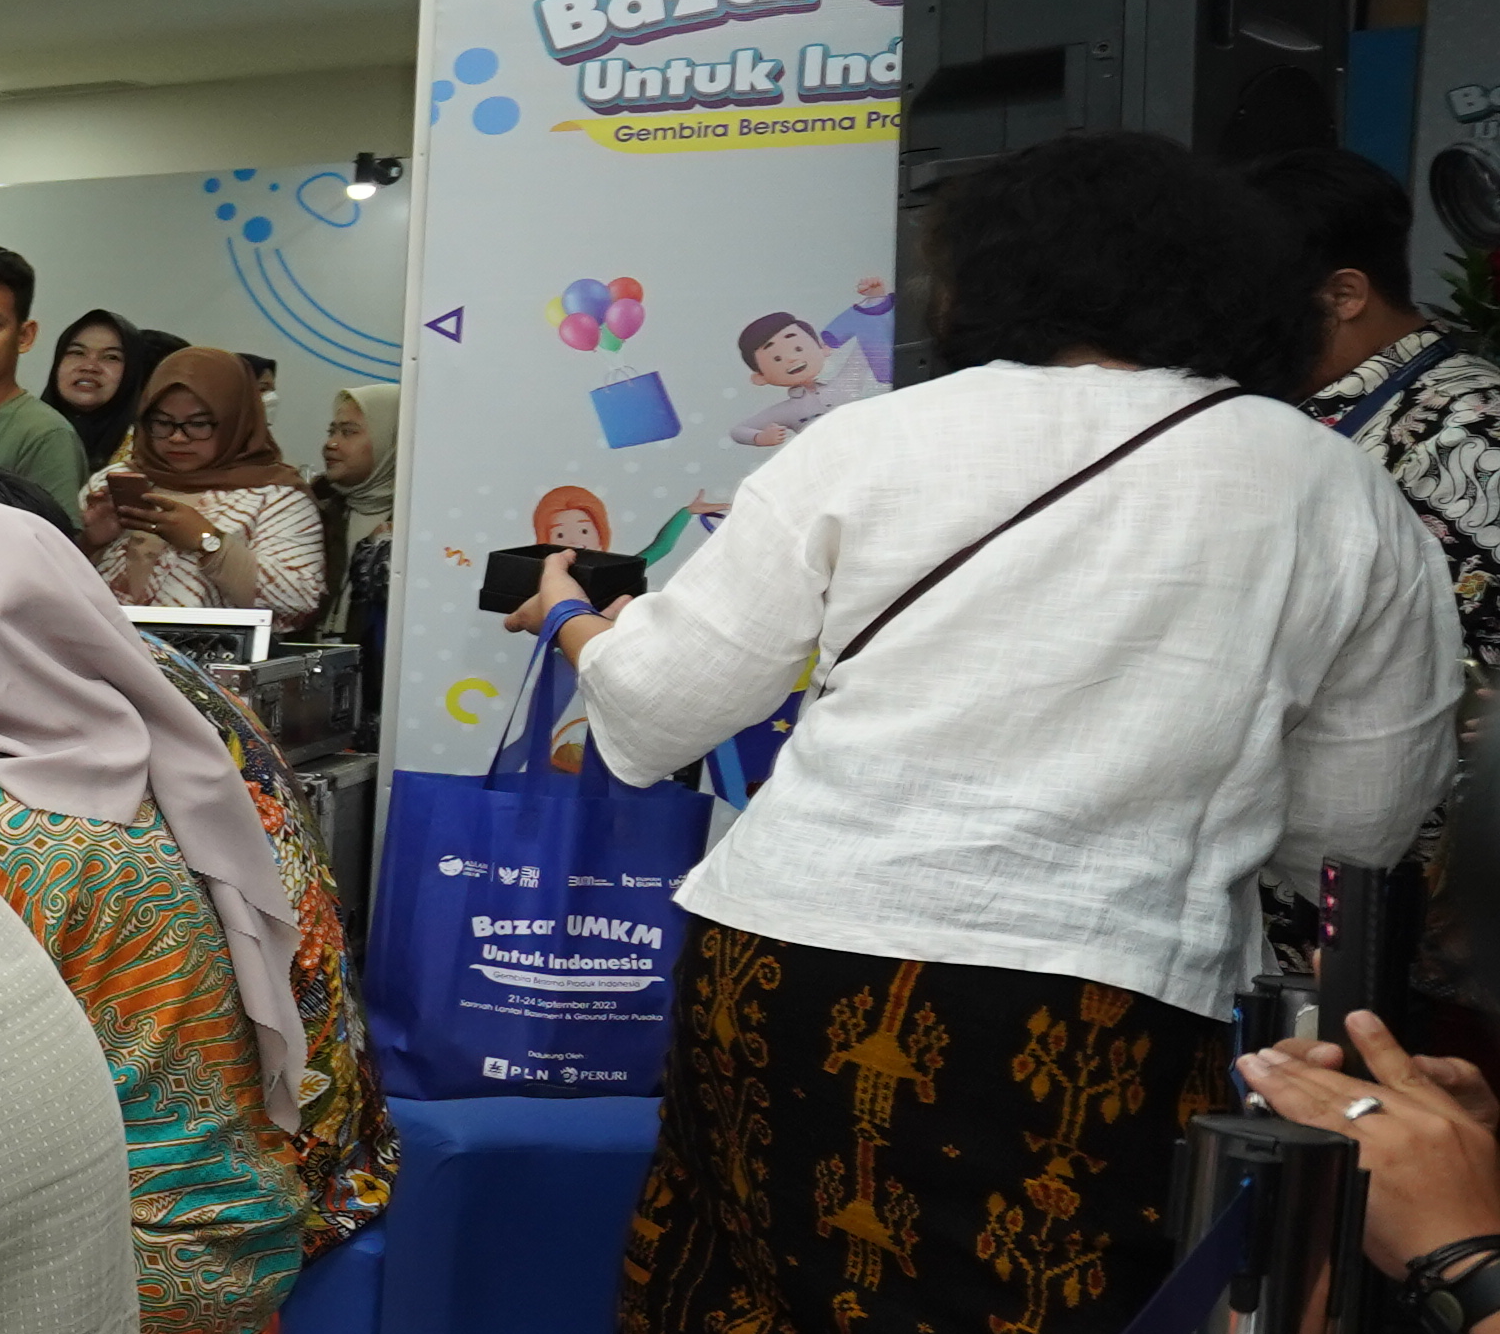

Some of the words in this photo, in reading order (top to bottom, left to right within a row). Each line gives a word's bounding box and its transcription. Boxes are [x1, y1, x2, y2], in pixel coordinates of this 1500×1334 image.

[582, 55, 778, 104] Untuk
[613, 119, 730, 143] Gembira
[737, 113, 856, 138] Bersama
[471, 915, 556, 938] Bazar
[566, 914, 663, 950] UMKM
[482, 943, 545, 968] Untuk
[548, 953, 653, 970] Indonesia
[508, 993, 536, 1005] 21-24
[537, 998, 590, 1010] September
[592, 1000, 617, 1010] 2023
[510, 1065, 549, 1081] PLN
[580, 1070, 628, 1081] PERURI
